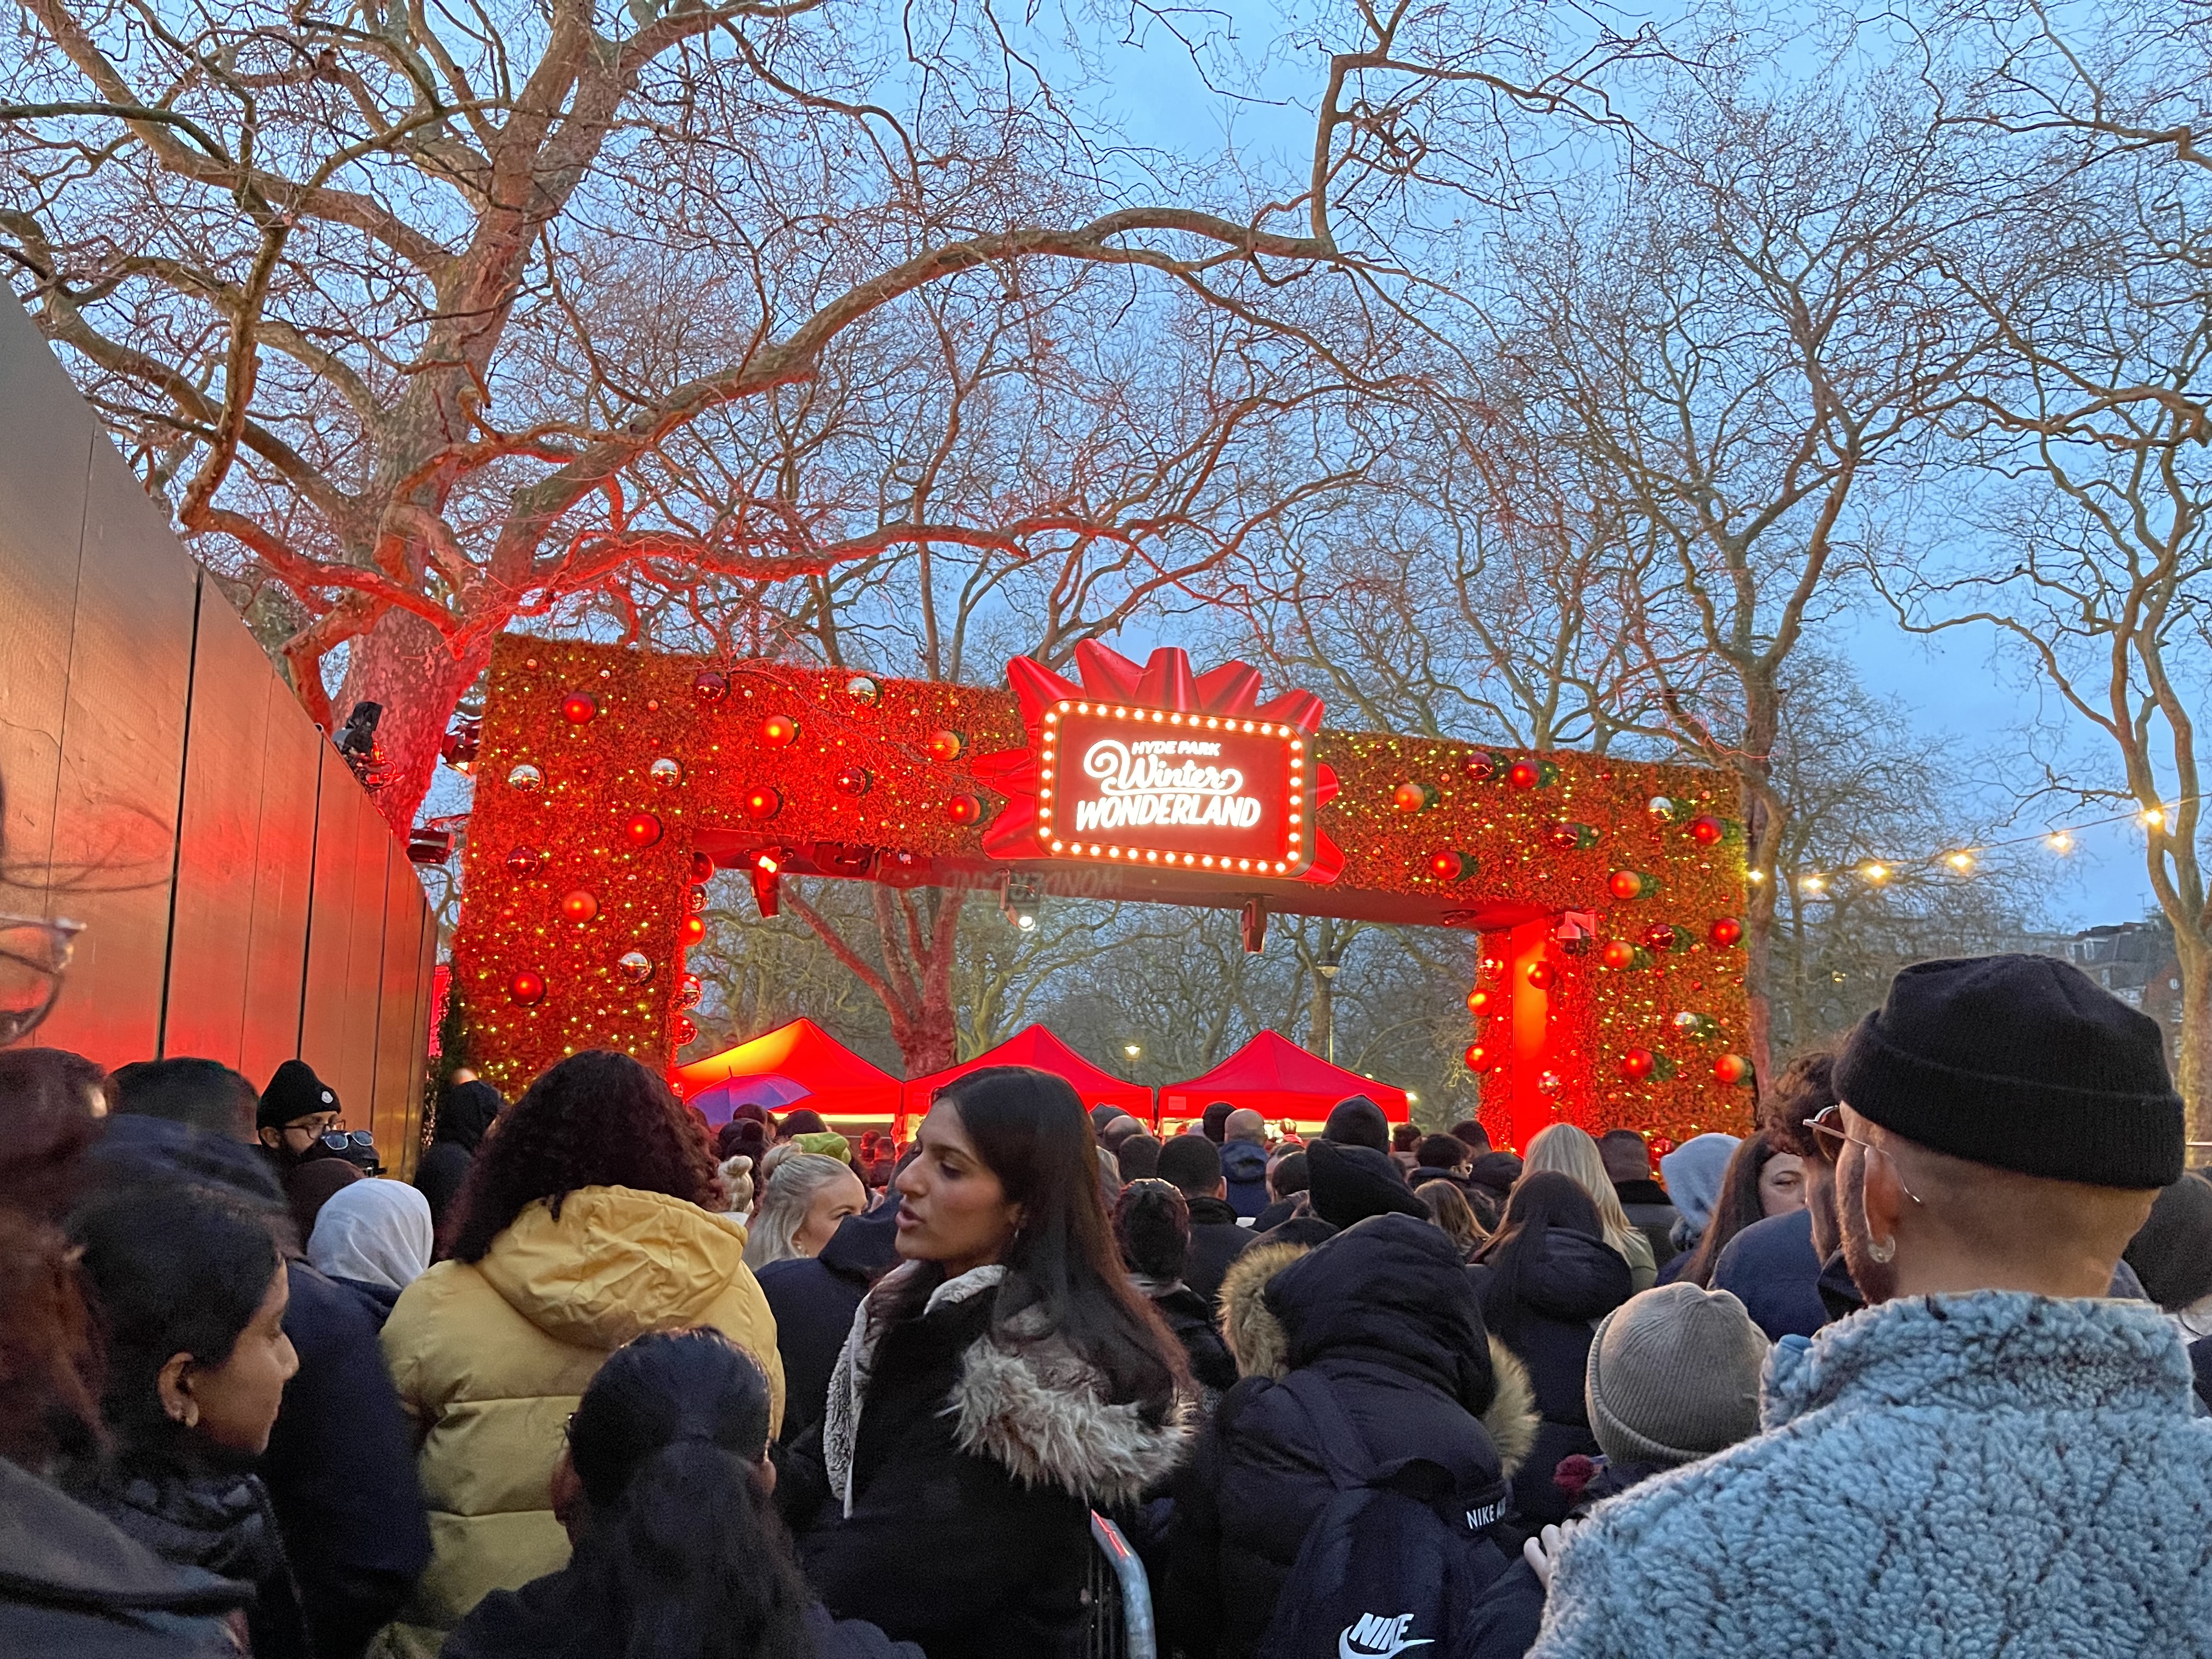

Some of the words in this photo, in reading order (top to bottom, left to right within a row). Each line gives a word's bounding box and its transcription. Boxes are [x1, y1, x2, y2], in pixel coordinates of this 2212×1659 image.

[1132, 741, 1177, 755] HYDE
[1178, 741, 1221, 756] PARK
[1083, 739, 1244, 796] Winter
[1076, 794, 1261, 831] WONDERLAND
[1466, 1504, 1494, 1530] NIKE
[1348, 1612, 1415, 1651] NIKE
